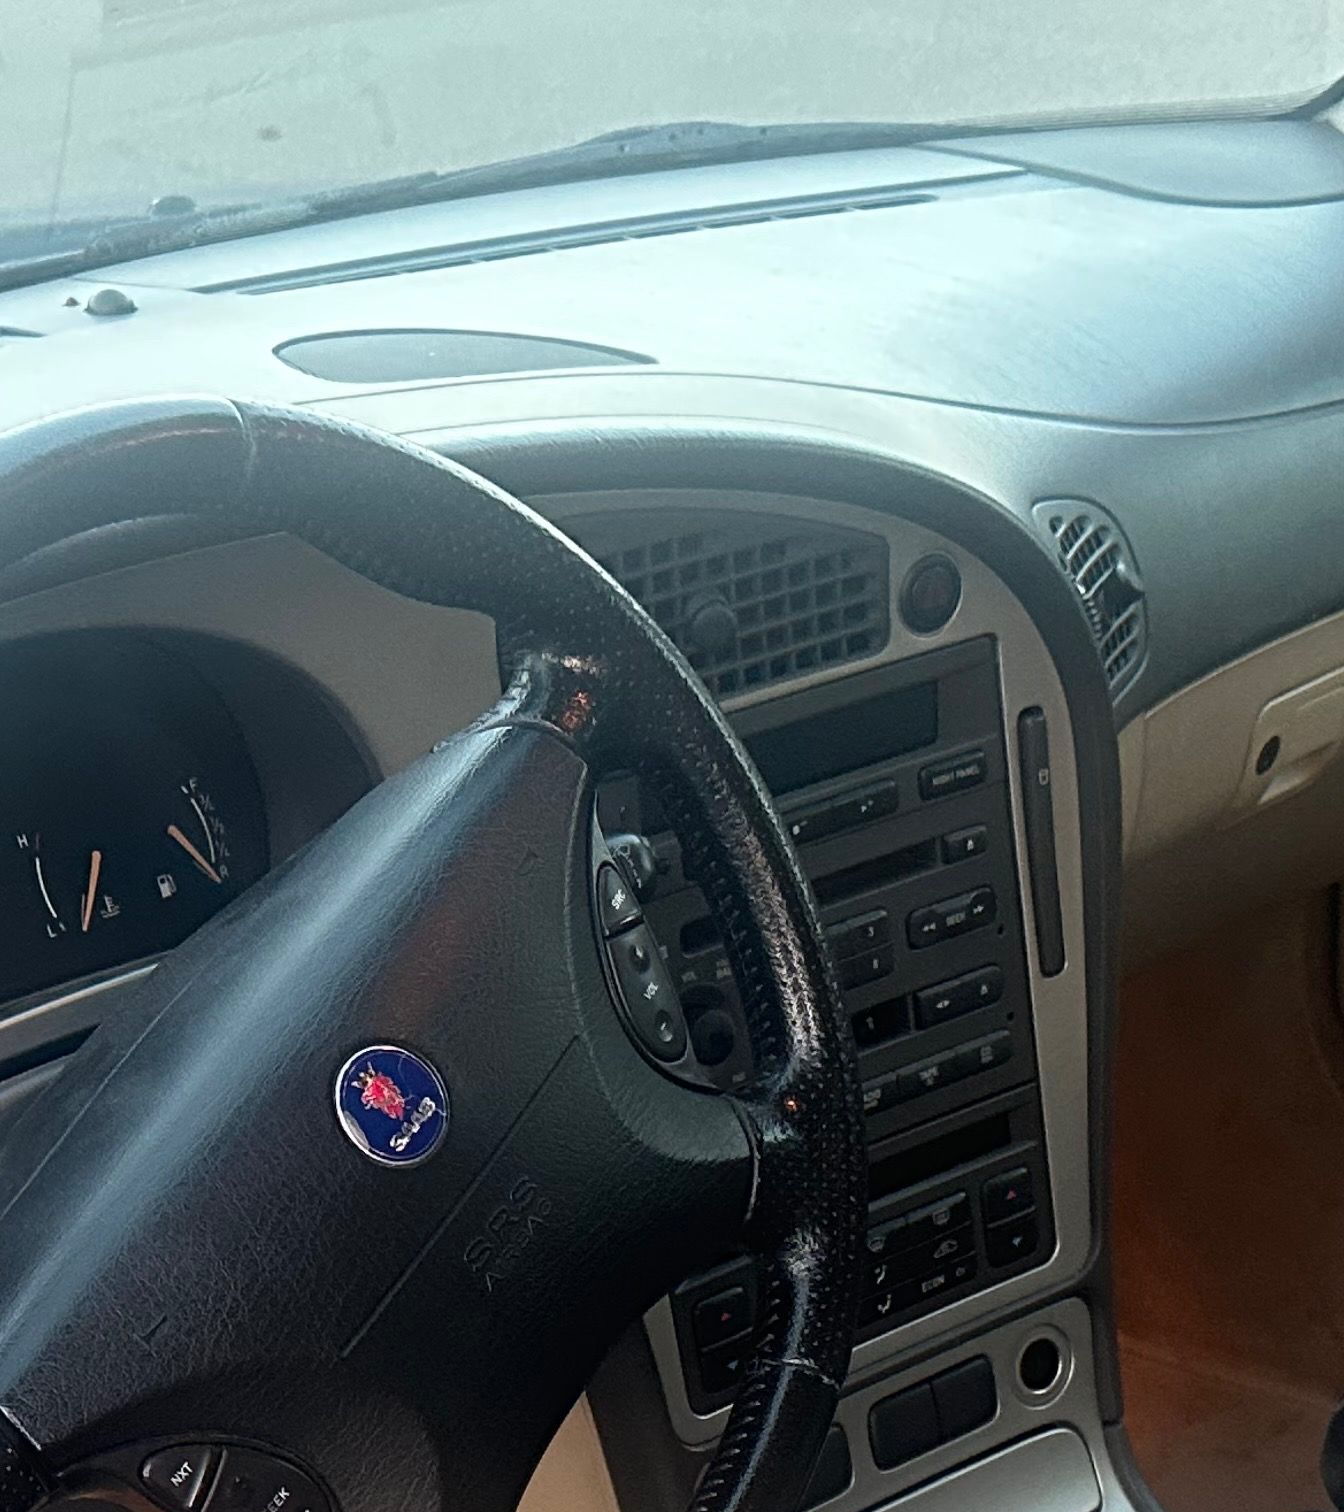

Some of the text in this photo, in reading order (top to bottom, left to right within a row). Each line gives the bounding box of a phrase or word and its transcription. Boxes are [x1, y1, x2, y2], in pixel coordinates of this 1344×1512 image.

[15, 833, 30, 849] H
[611, 888, 626, 911] SRC
[643, 981, 659, 1000] VOL
[389, 1096, 437, 1152] SAAB
[463, 1175, 539, 1272] SRS
[169, 1460, 194, 1488] NXT
